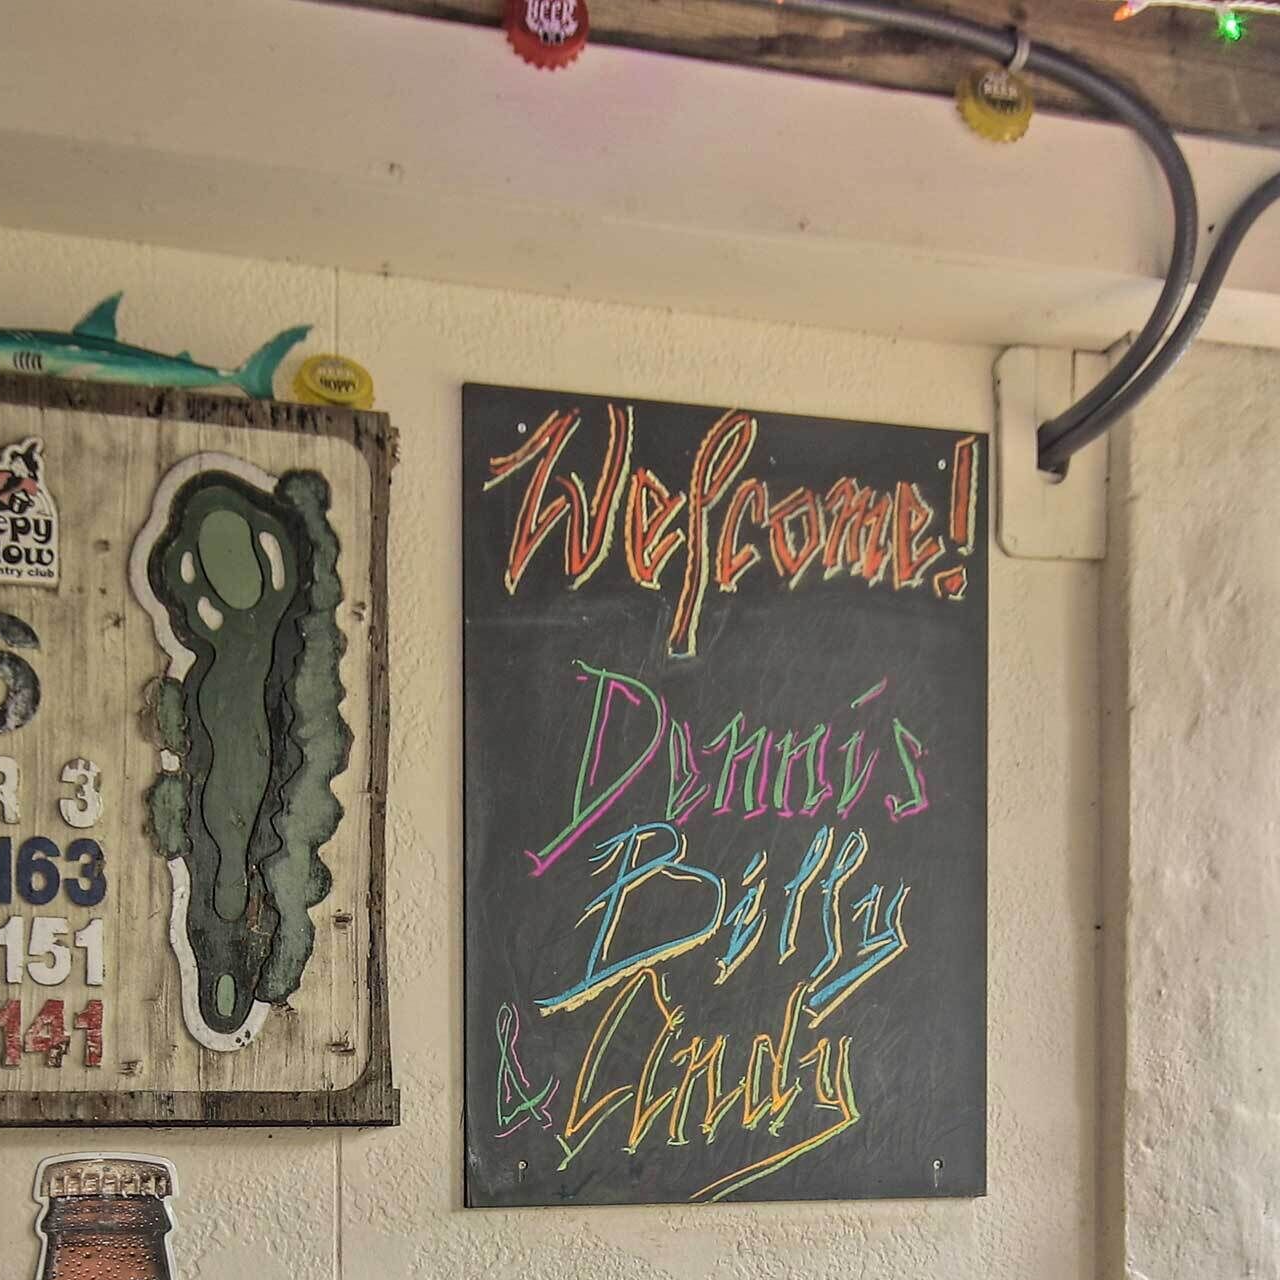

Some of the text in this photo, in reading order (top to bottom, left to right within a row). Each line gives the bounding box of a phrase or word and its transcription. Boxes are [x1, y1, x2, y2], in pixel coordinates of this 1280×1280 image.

[27, 568, 55, 578] club
[483, 405, 978, 658] Welcome!
[57, 756, 104, 828] 3
[526, 659, 928, 876] Dennis
[536, 822, 909, 1028] Billy
